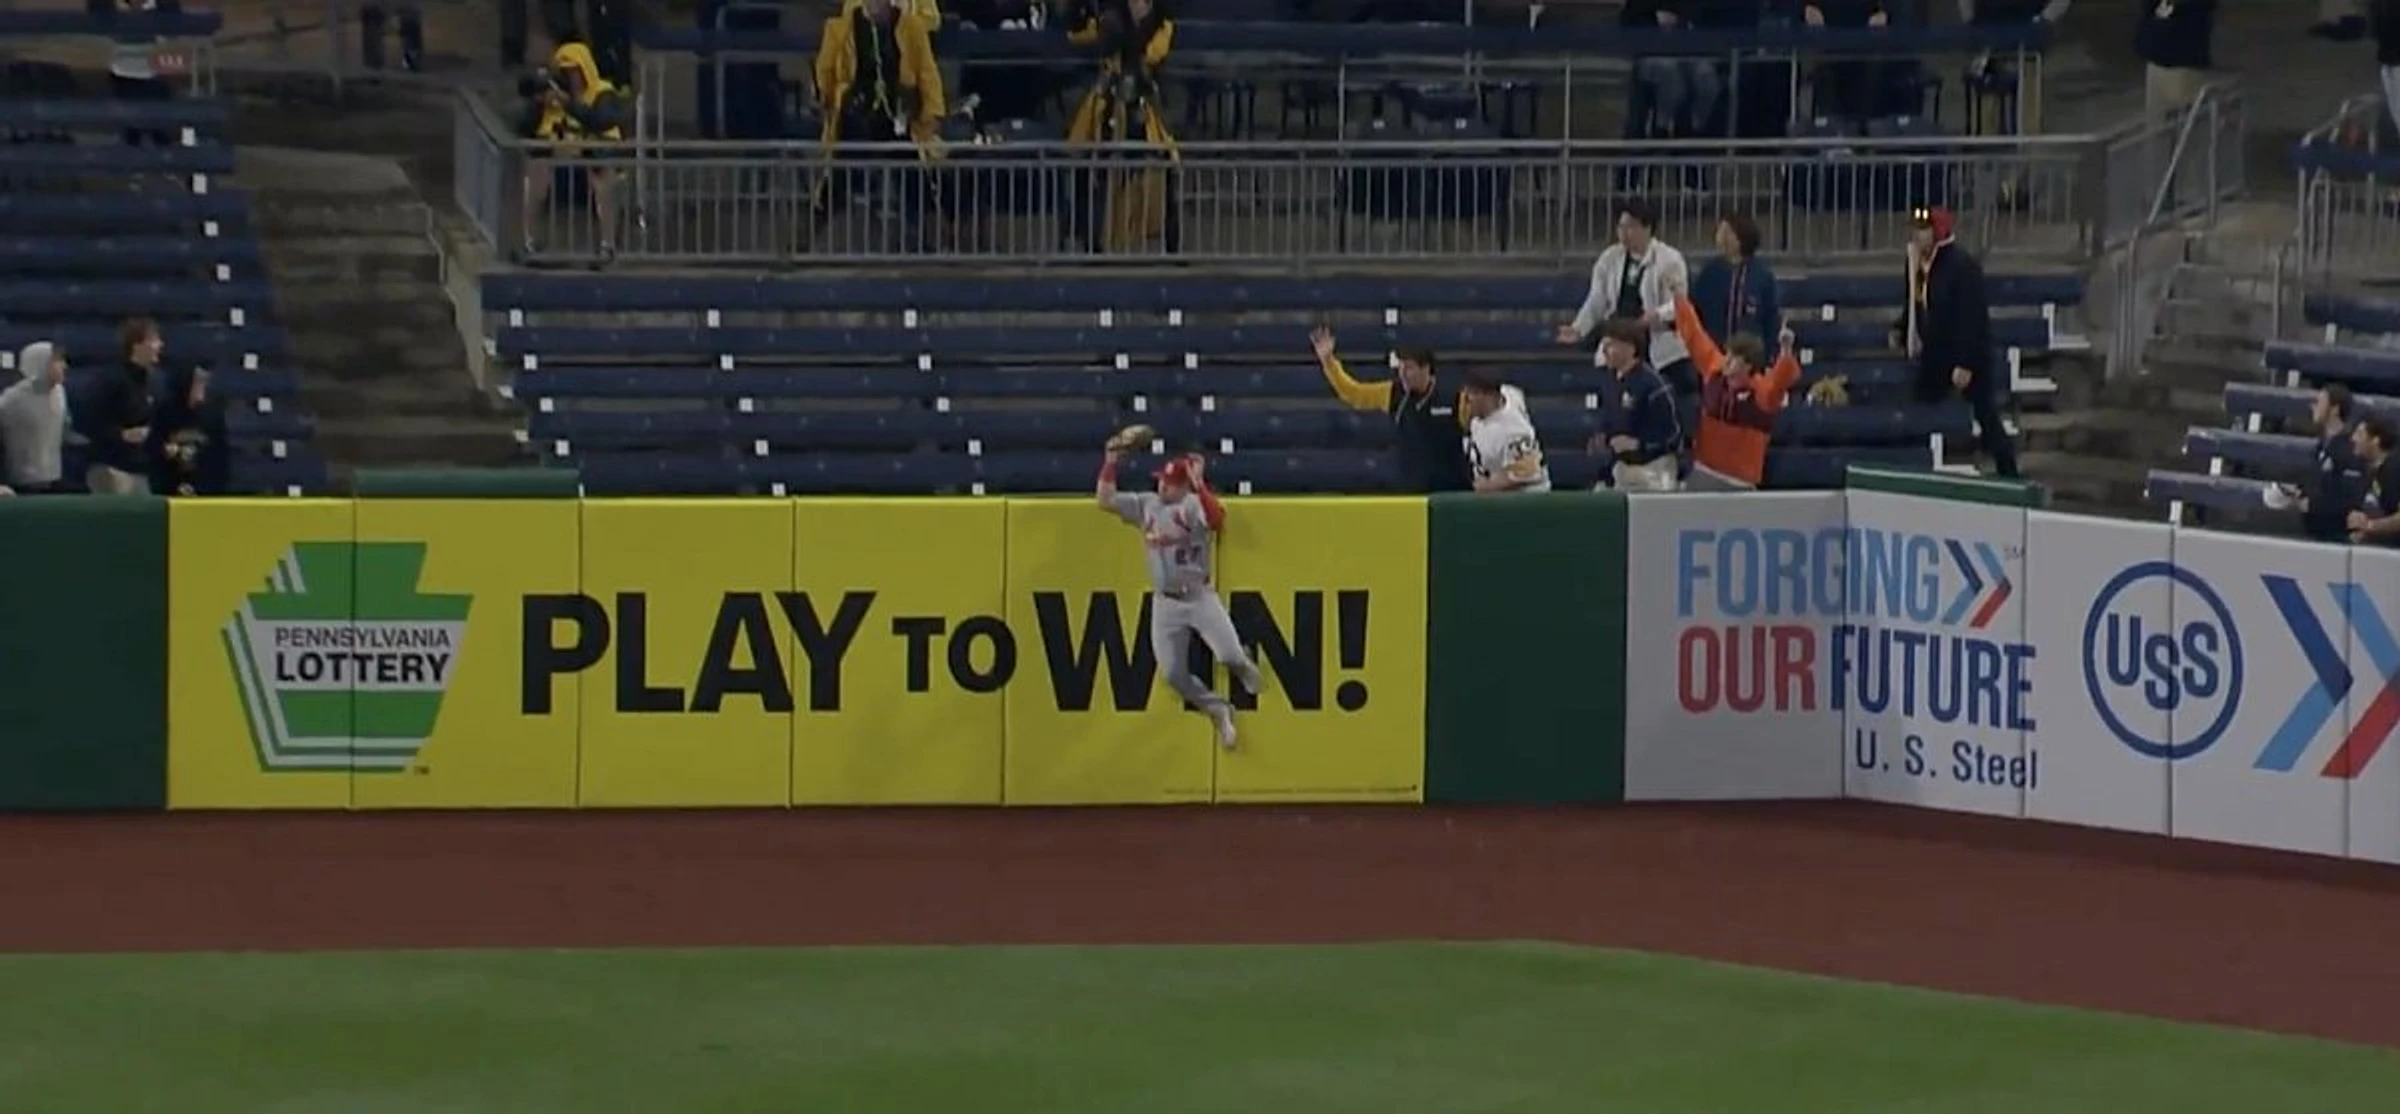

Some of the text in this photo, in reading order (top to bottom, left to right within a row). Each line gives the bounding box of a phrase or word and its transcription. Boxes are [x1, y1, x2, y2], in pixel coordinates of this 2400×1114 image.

[1677, 528, 1939, 623] FORGING
[275, 627, 451, 648] PENNSYLVANIA
[276, 651, 451, 683] LOTTERY
[521, 591, 877, 714] PLAY
[892, 615, 1016, 693] TO
[1679, 624, 2037, 731] OUR FUTURE
[2106, 612, 2219, 711] USS
[1855, 728, 2038, 789] U. S. Steel
